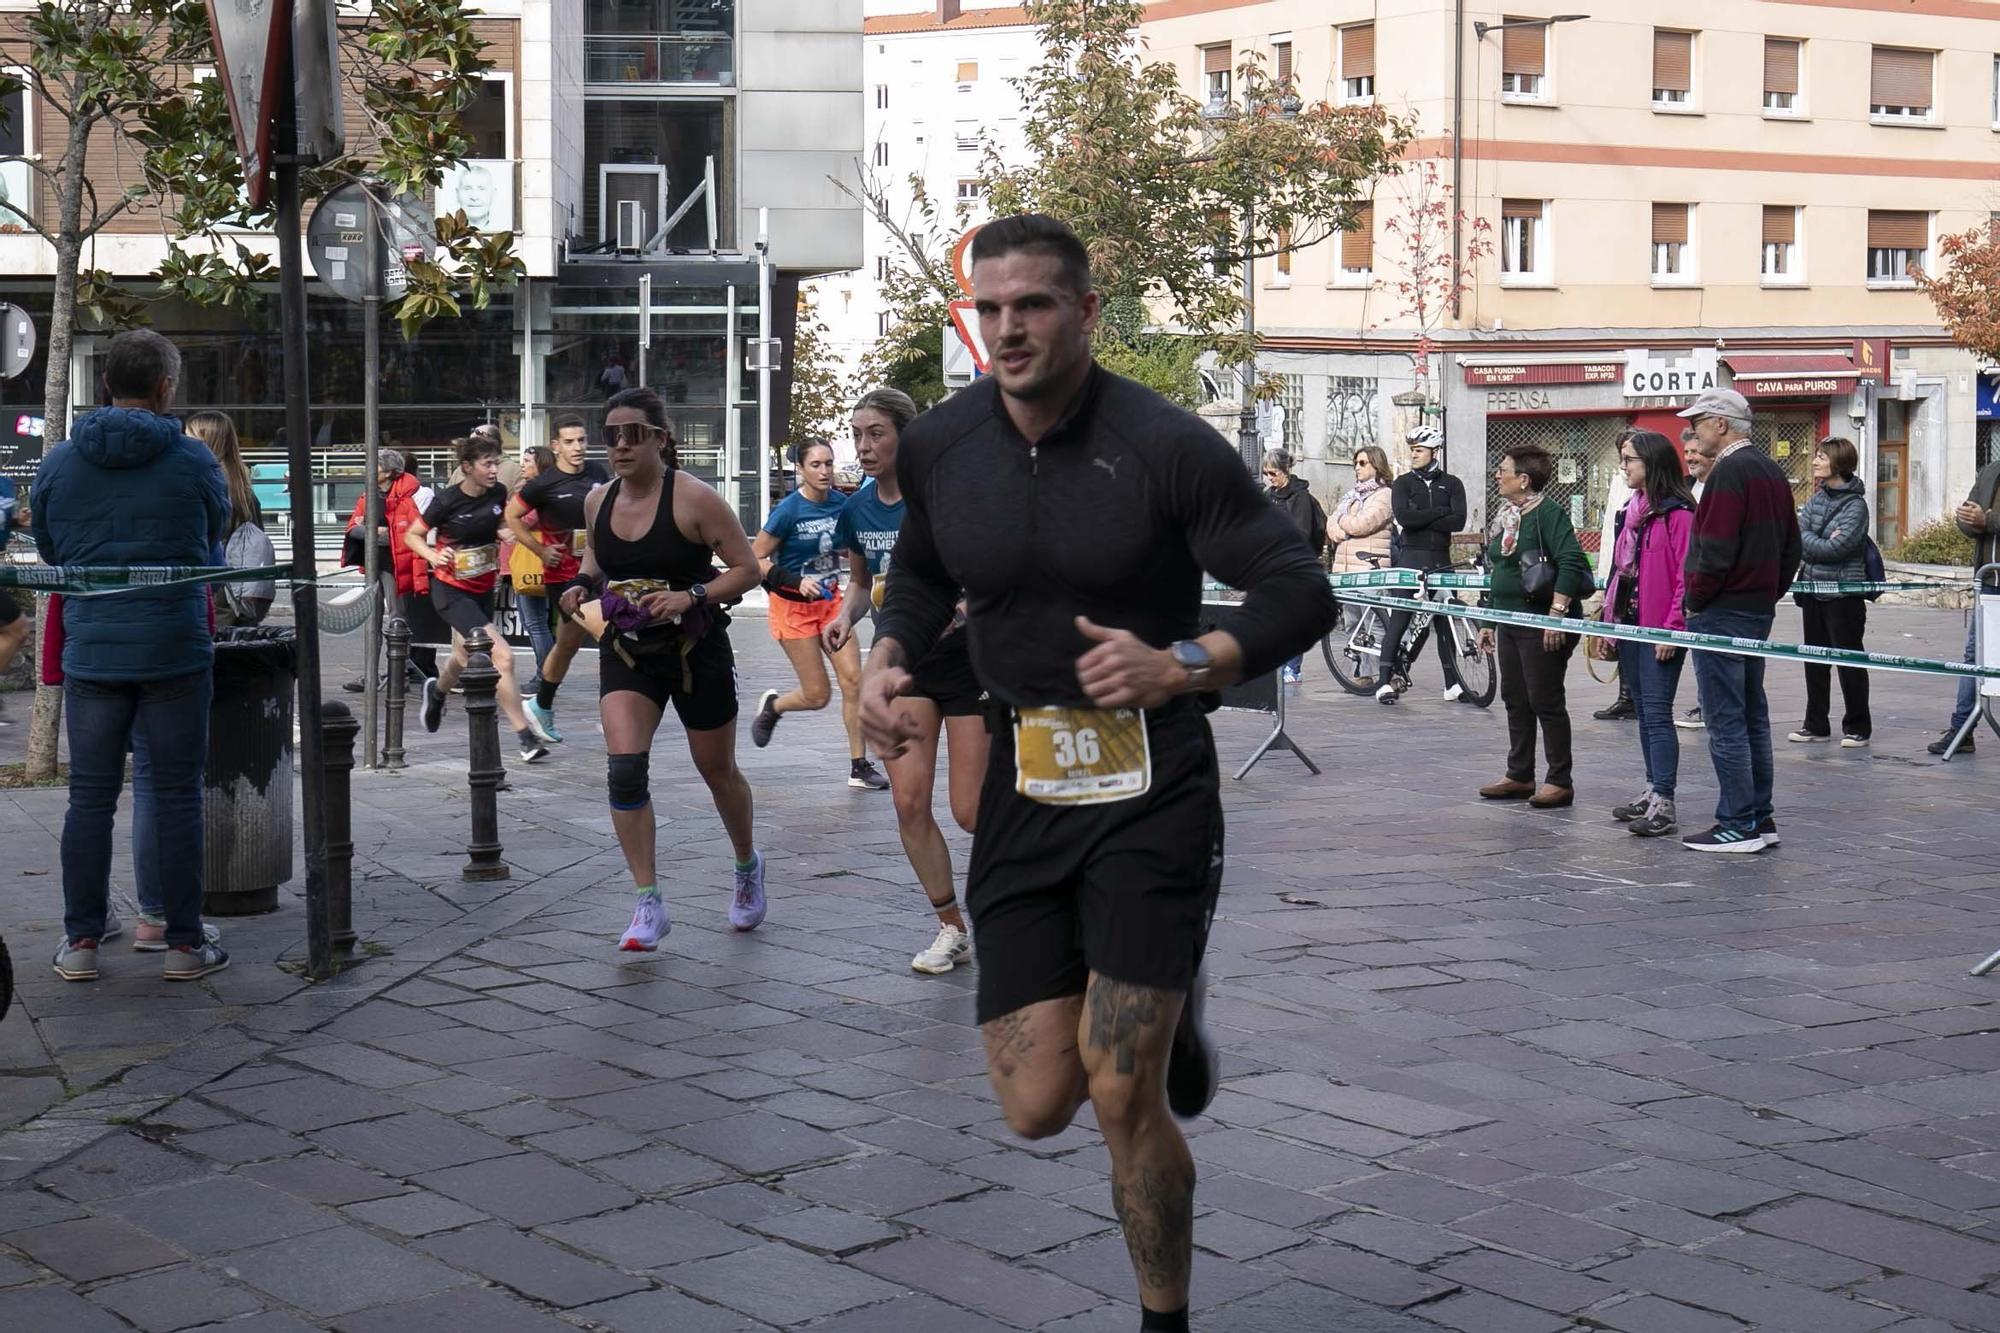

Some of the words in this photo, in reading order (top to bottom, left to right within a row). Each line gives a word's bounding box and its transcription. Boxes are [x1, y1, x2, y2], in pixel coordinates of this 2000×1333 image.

[1632, 371, 1714, 391] CORTA
[1756, 382, 1783, 392] CAVA
[1784, 383, 1803, 391] PARA
[1804, 380, 1838, 390] PUROS
[1487, 391, 1551, 410] PRENSA
[493, 610, 530, 636] AST
[1052, 728, 1101, 768] 36
